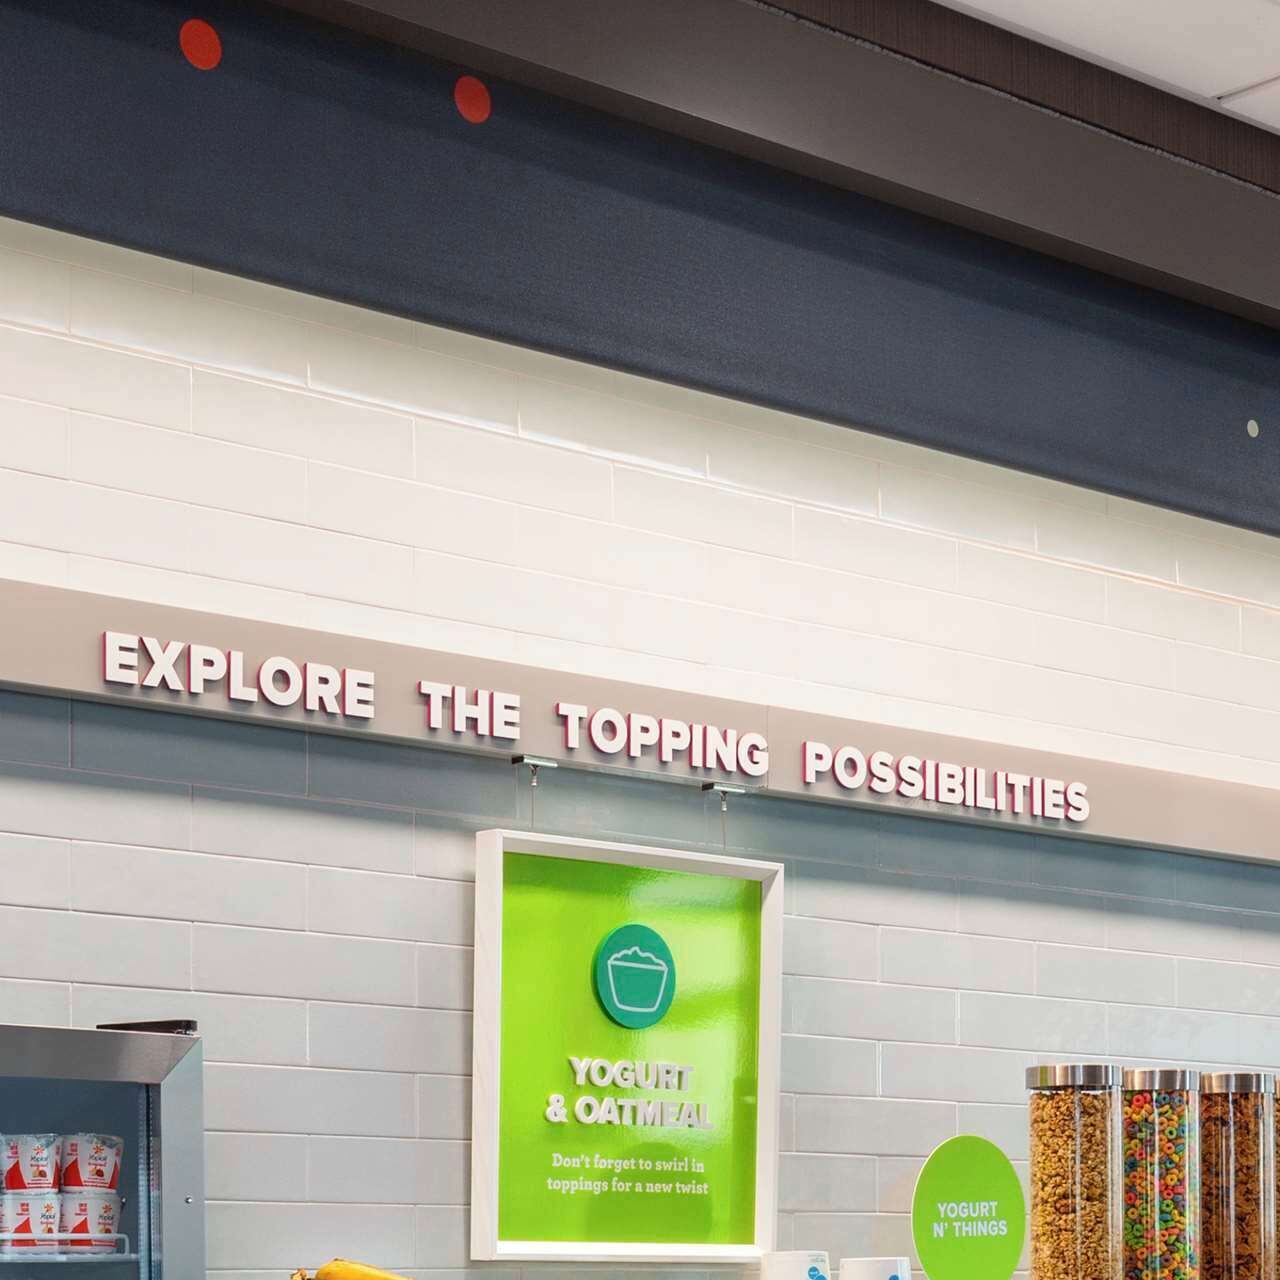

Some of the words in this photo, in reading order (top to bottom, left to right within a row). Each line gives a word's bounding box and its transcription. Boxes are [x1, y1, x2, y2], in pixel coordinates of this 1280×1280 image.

[102, 631, 376, 720] EXPLORE
[418, 680, 521, 741] THE
[556, 701, 769, 777] TOPPING
[803, 740, 1091, 823] POSSIBILITIES
[568, 1056, 695, 1092] YOGURT
[545, 1094, 568, 1124] &
[574, 1095, 714, 1130] OATMEAL
[552, 1152, 591, 1169] Don't
[593, 1154, 636, 1173] forget
[639, 1157, 652, 1170] to
[655, 1154, 690, 1171] swirl
[692, 1157, 704, 1172] in
[547, 1176, 608, 1195] toppings
[611, 1177, 633, 1192] for
[636, 1181, 644, 1192] a
[646, 1180, 672, 1193] new
[675, 1179, 708, 1195] twist
[938, 1201, 997, 1218] YOGURT
[933, 1222, 948, 1238] N'
[953, 1220, 1008, 1237] THINGS
